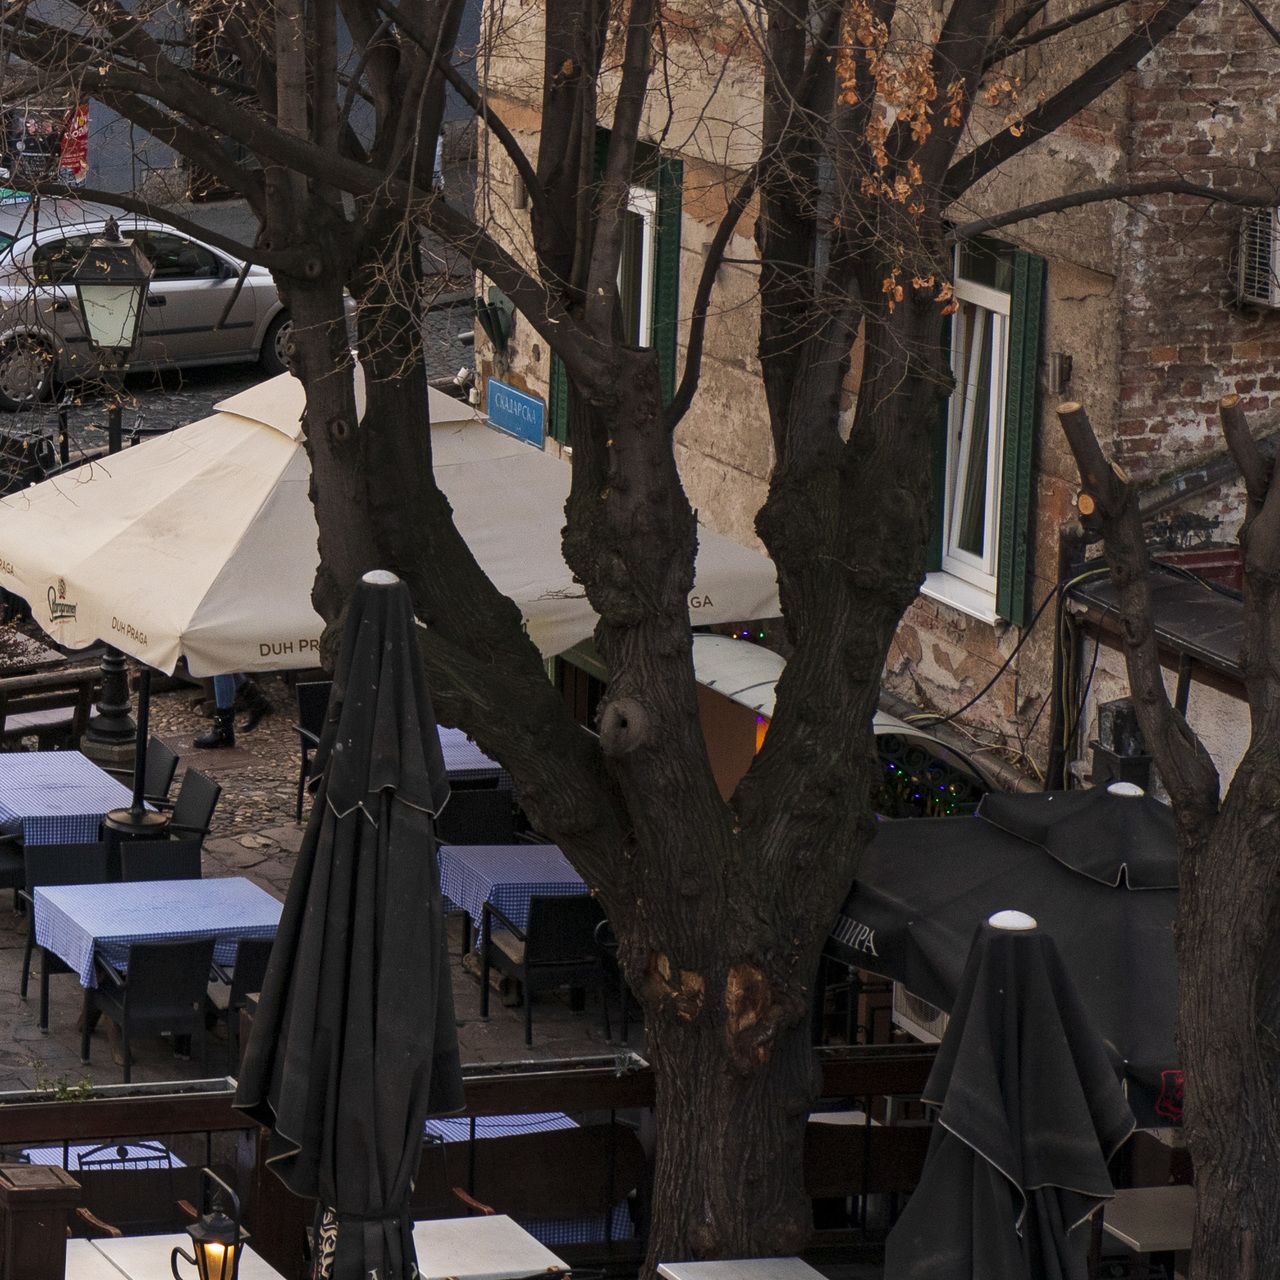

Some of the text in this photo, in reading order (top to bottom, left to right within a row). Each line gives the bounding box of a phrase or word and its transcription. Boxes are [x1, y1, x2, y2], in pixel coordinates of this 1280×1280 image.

[111, 616, 148, 646] DUH PRAGA
[259, 639, 320, 657] DUH PR
